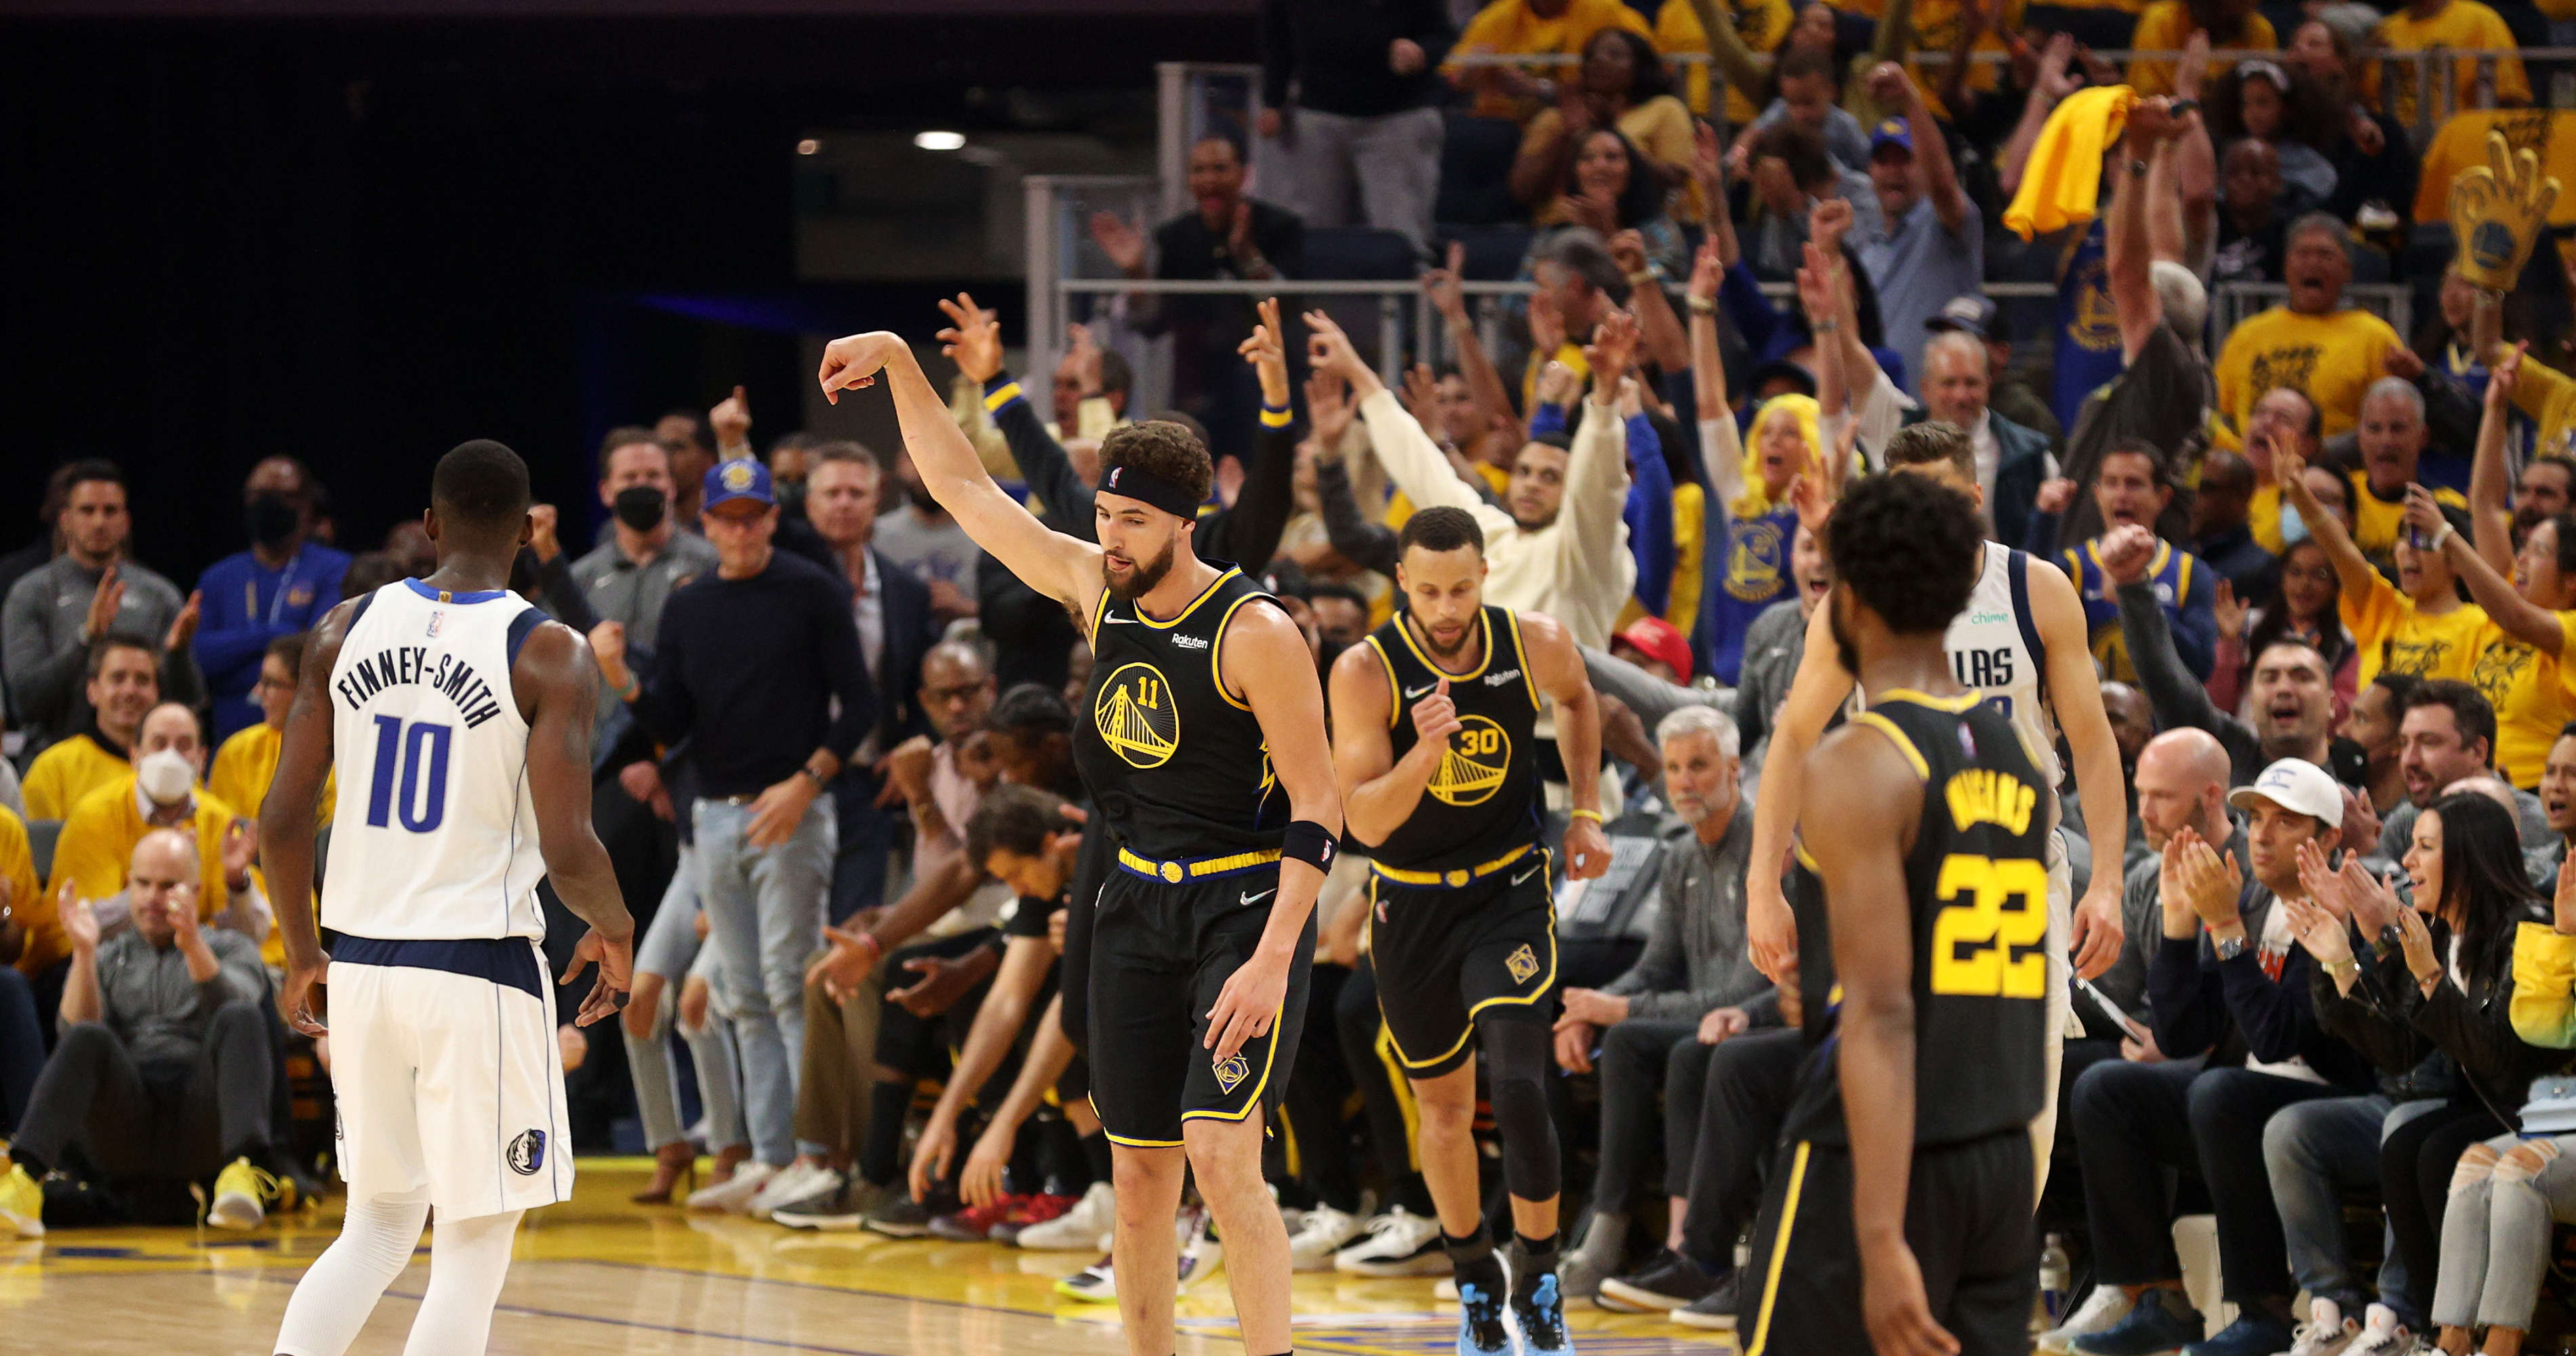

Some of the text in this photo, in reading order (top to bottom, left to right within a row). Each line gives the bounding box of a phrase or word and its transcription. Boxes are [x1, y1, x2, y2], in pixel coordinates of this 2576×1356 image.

[1971, 611, 2009, 624] chime
[1171, 633, 1208, 649] Rakuten
[1483, 669, 1521, 687] Rakuten
[1955, 647, 2014, 688] LAS
[337, 647, 501, 730] FINNEY-SMITH
[1137, 676, 1159, 710] 11
[1460, 727, 1499, 756] 30
[366, 713, 453, 833] 10
[1930, 853, 2049, 1000] 22
